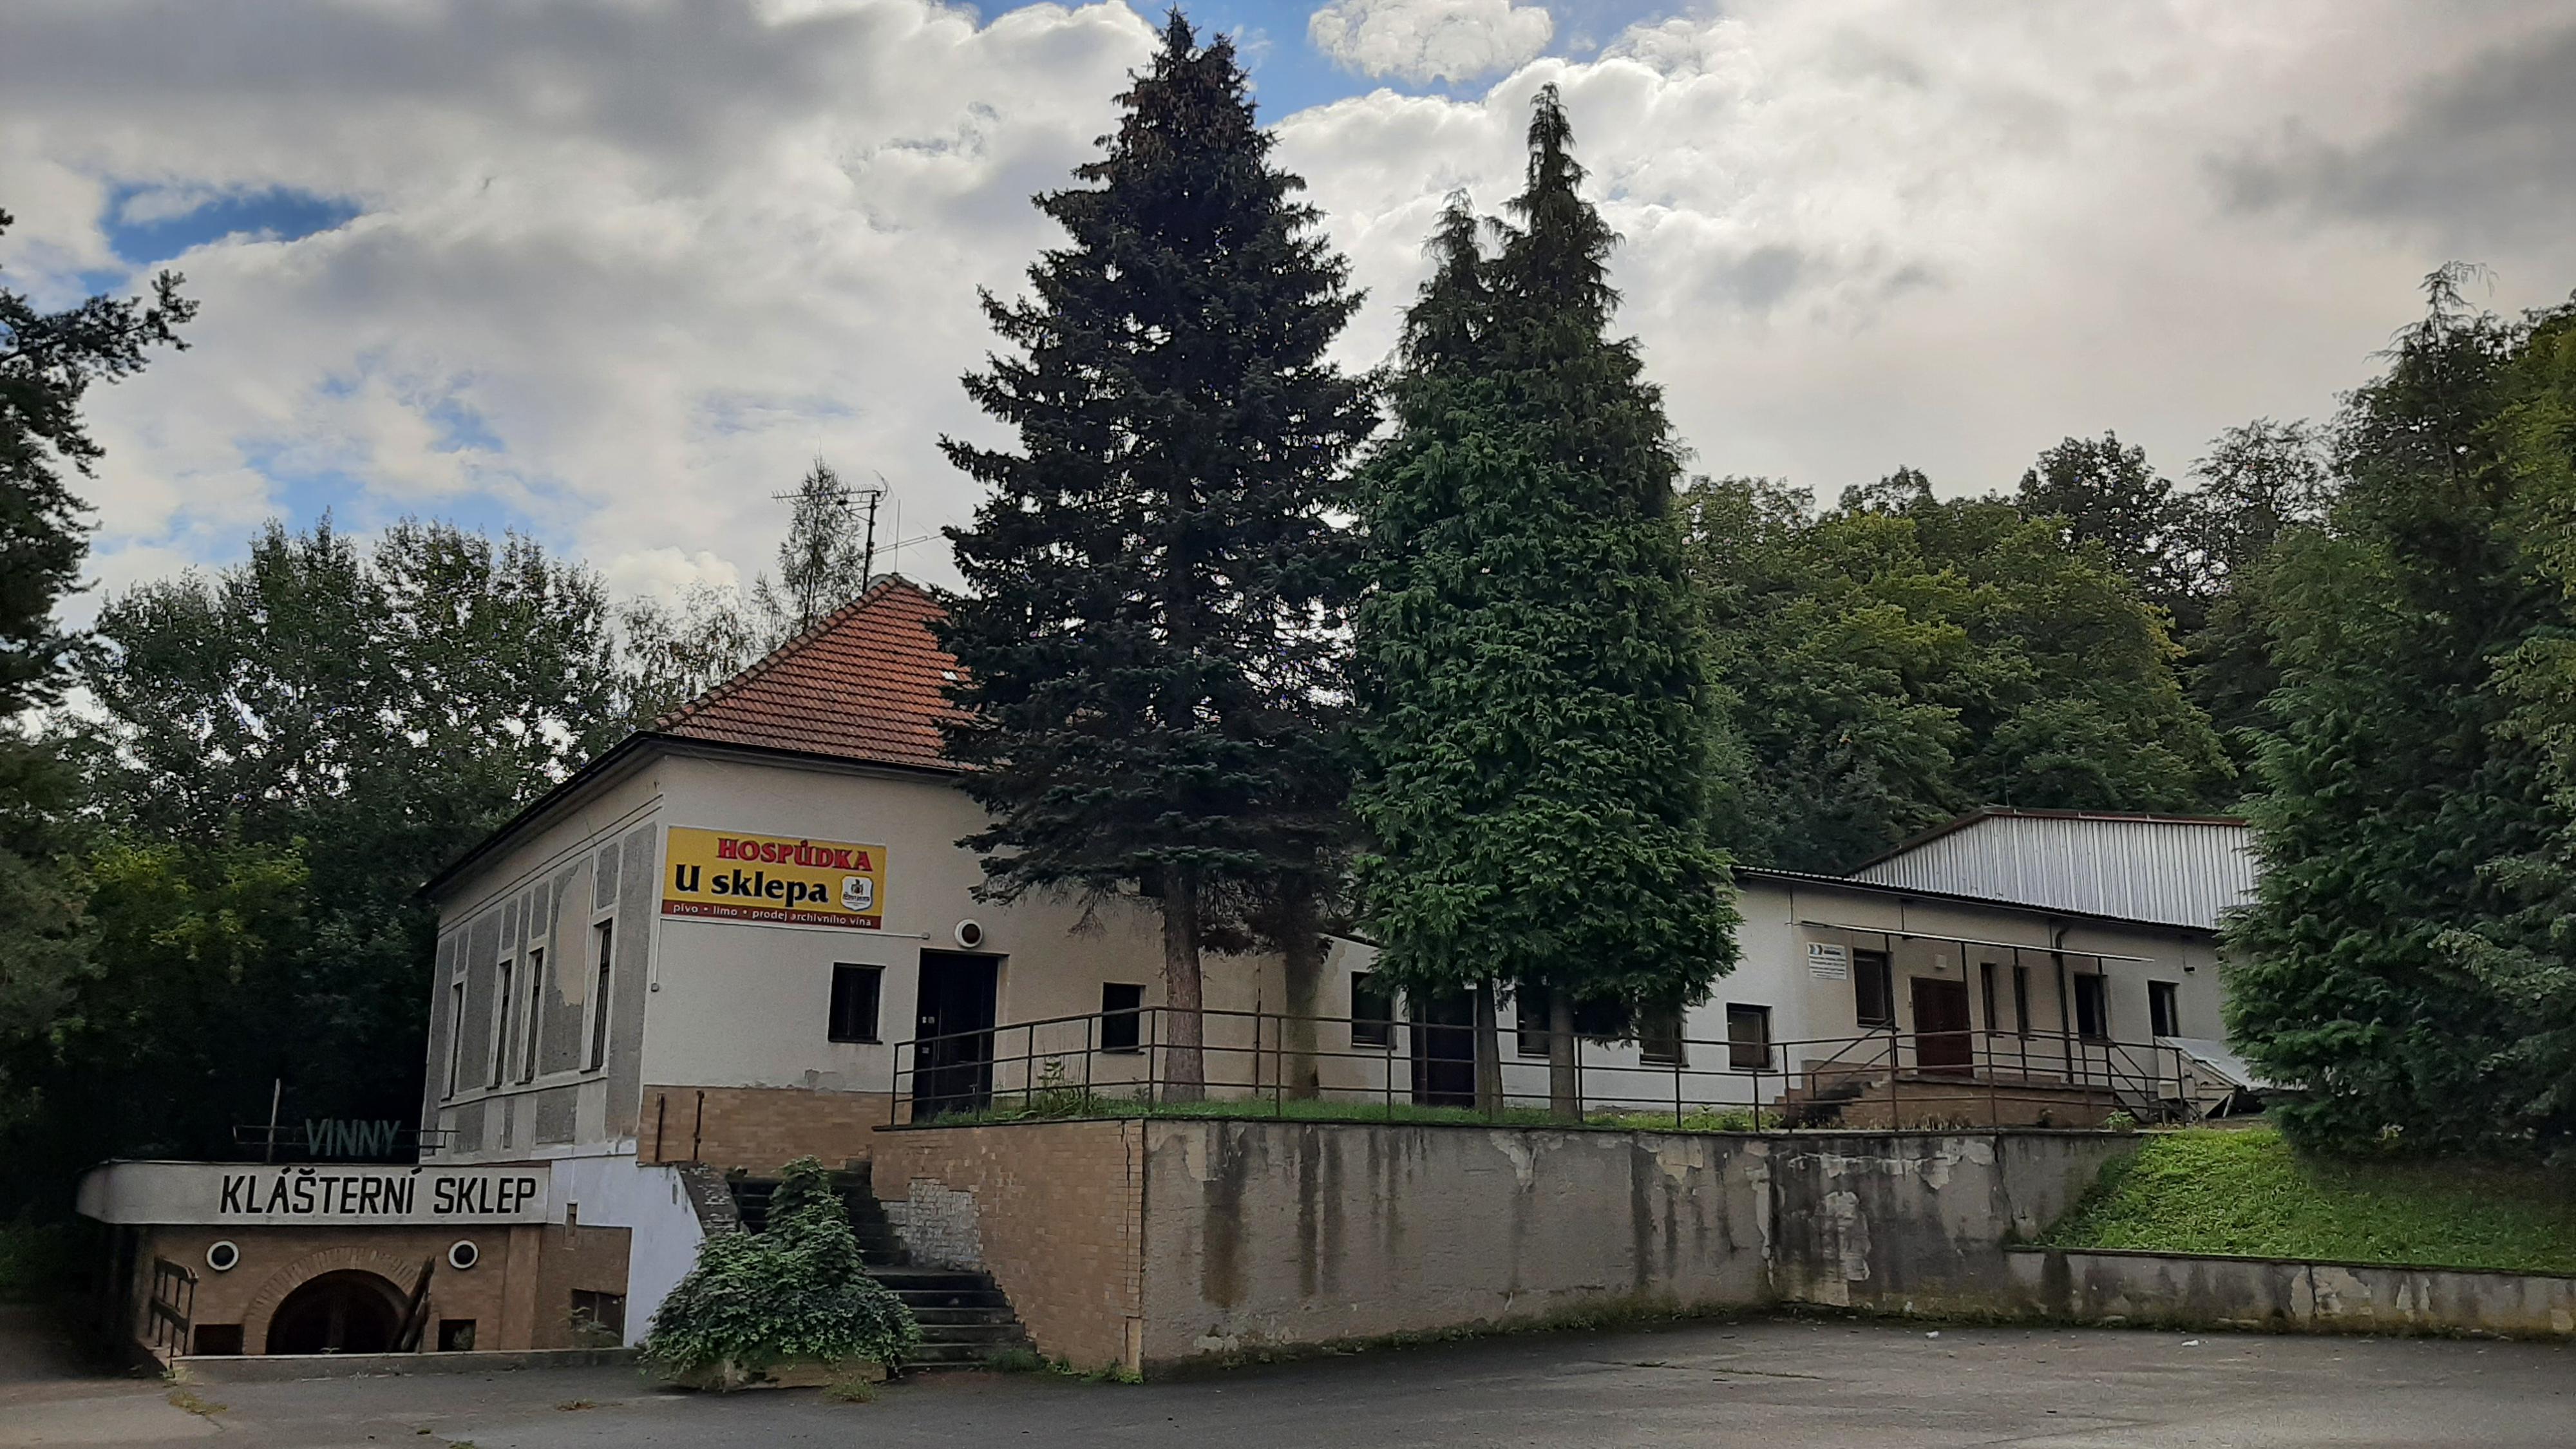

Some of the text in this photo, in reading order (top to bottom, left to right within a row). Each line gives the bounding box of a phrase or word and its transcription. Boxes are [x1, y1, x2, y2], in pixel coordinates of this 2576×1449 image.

[711, 869, 828, 907] sklepa
[674, 903, 699, 914] pivo
[713, 905, 738, 916] limo
[752, 908, 788, 922] prodej
[220, 1166, 536, 1214] KLÁŠTERNÍ SKLEP
